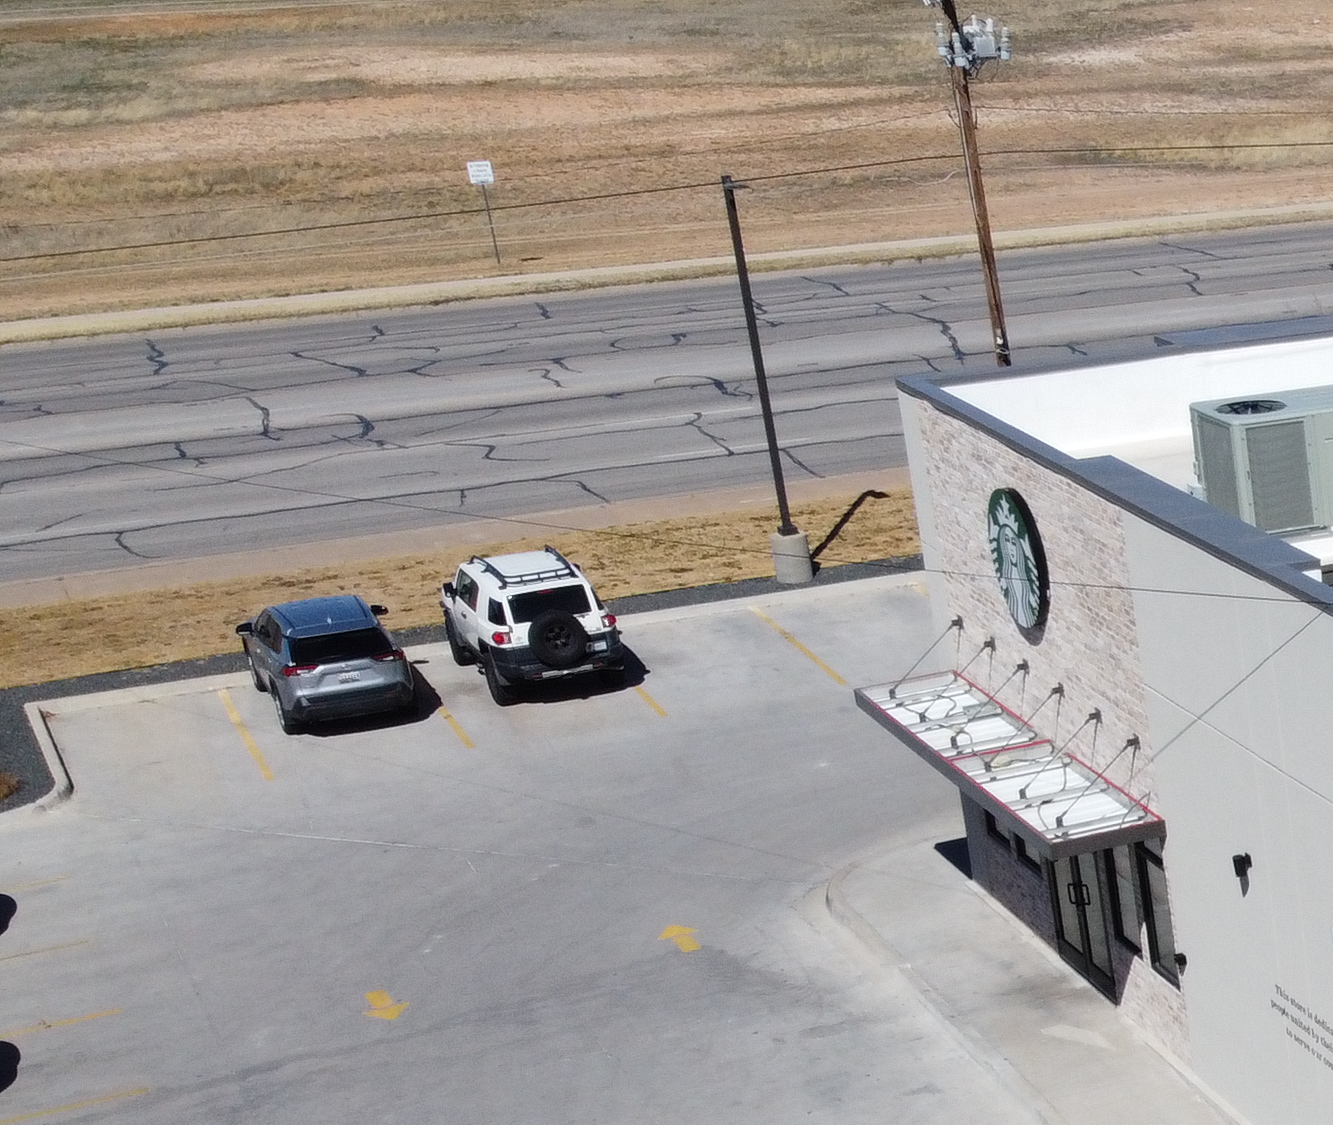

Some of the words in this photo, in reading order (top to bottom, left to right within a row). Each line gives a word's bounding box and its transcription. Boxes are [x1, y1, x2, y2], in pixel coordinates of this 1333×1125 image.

[1275, 984, 1289, 1001] This
[1290, 997, 1306, 1015] store
[1307, 1007, 1313, 1020] is
[1270, 999, 1289, 1019] people
[1290, 1014, 1311, 1035] united
[1311, 1028, 1319, 1043] by
[1286, 1027, 1293, 1038] to
[1293, 1034, 1310, 1052] serve
[1311, 1048, 1322, 1061] our
